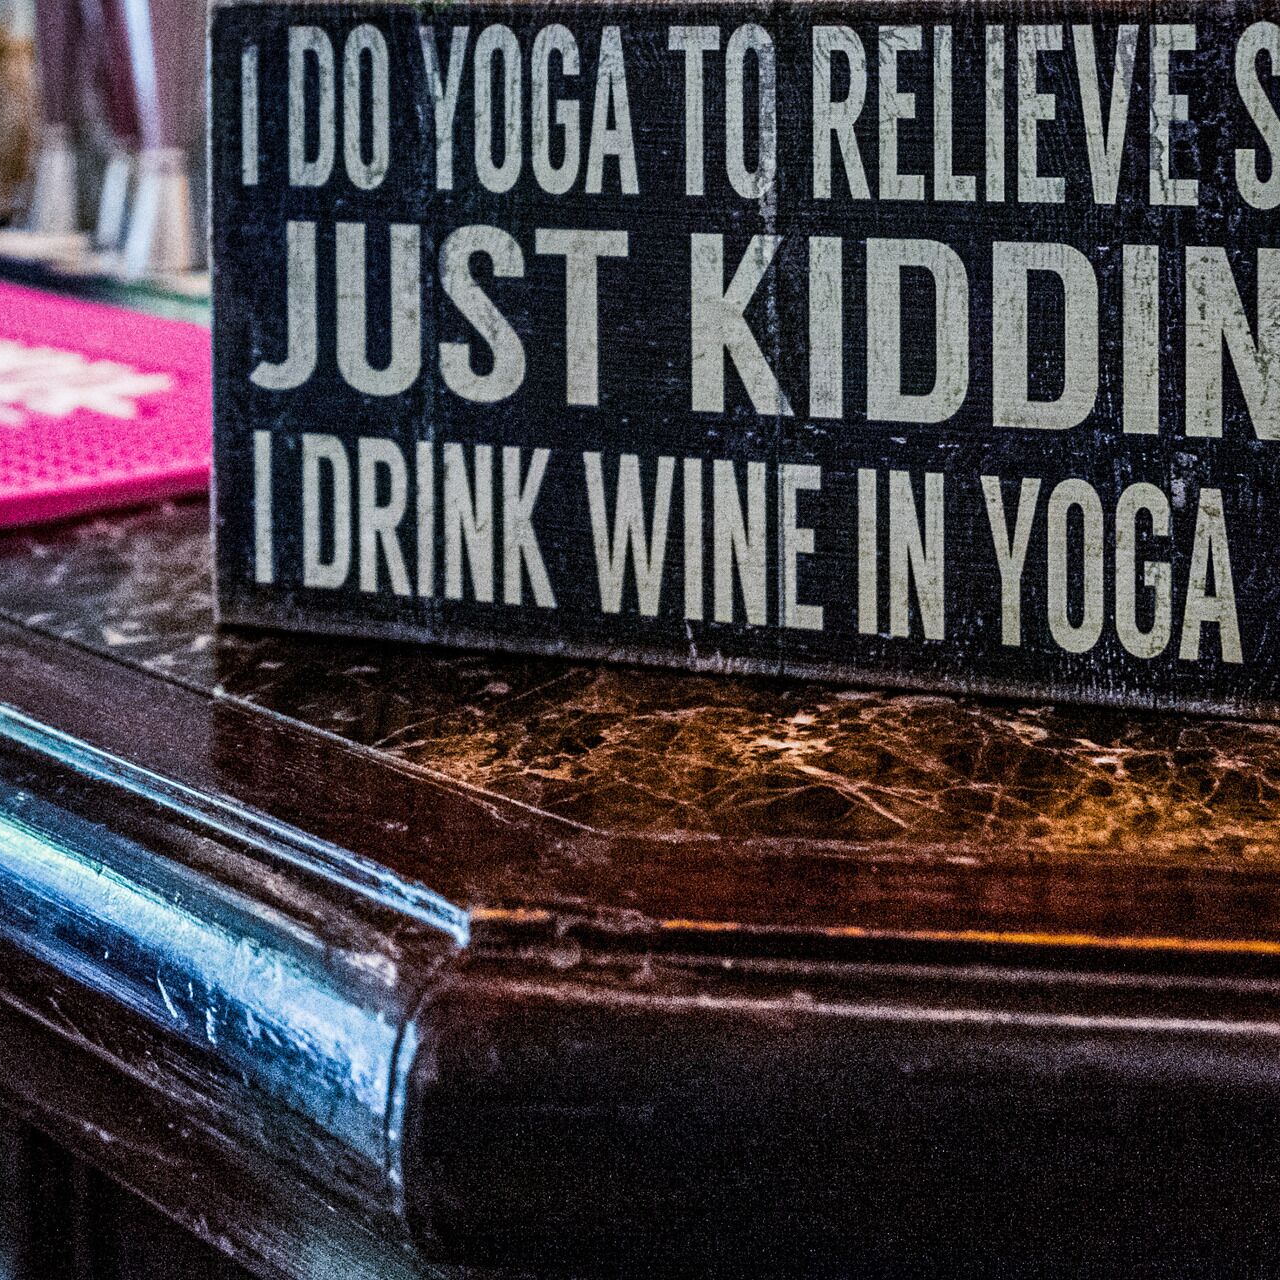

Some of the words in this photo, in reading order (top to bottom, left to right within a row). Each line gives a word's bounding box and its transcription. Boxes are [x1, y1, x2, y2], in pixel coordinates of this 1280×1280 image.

[241, 44, 258, 186] I
[288, 23, 390, 191] DO
[420, 23, 639, 196] YOGA
[667, 23, 778, 200] TO
[812, 23, 1199, 207] RELIEVE
[249, 220, 629, 407] JUST
[253, 430, 274, 584] I
[301, 432, 559, 609] DRINK
[583, 450, 824, 631] WINE
[857, 468, 945, 640] IN
[980, 475, 1243, 665] YOGA
